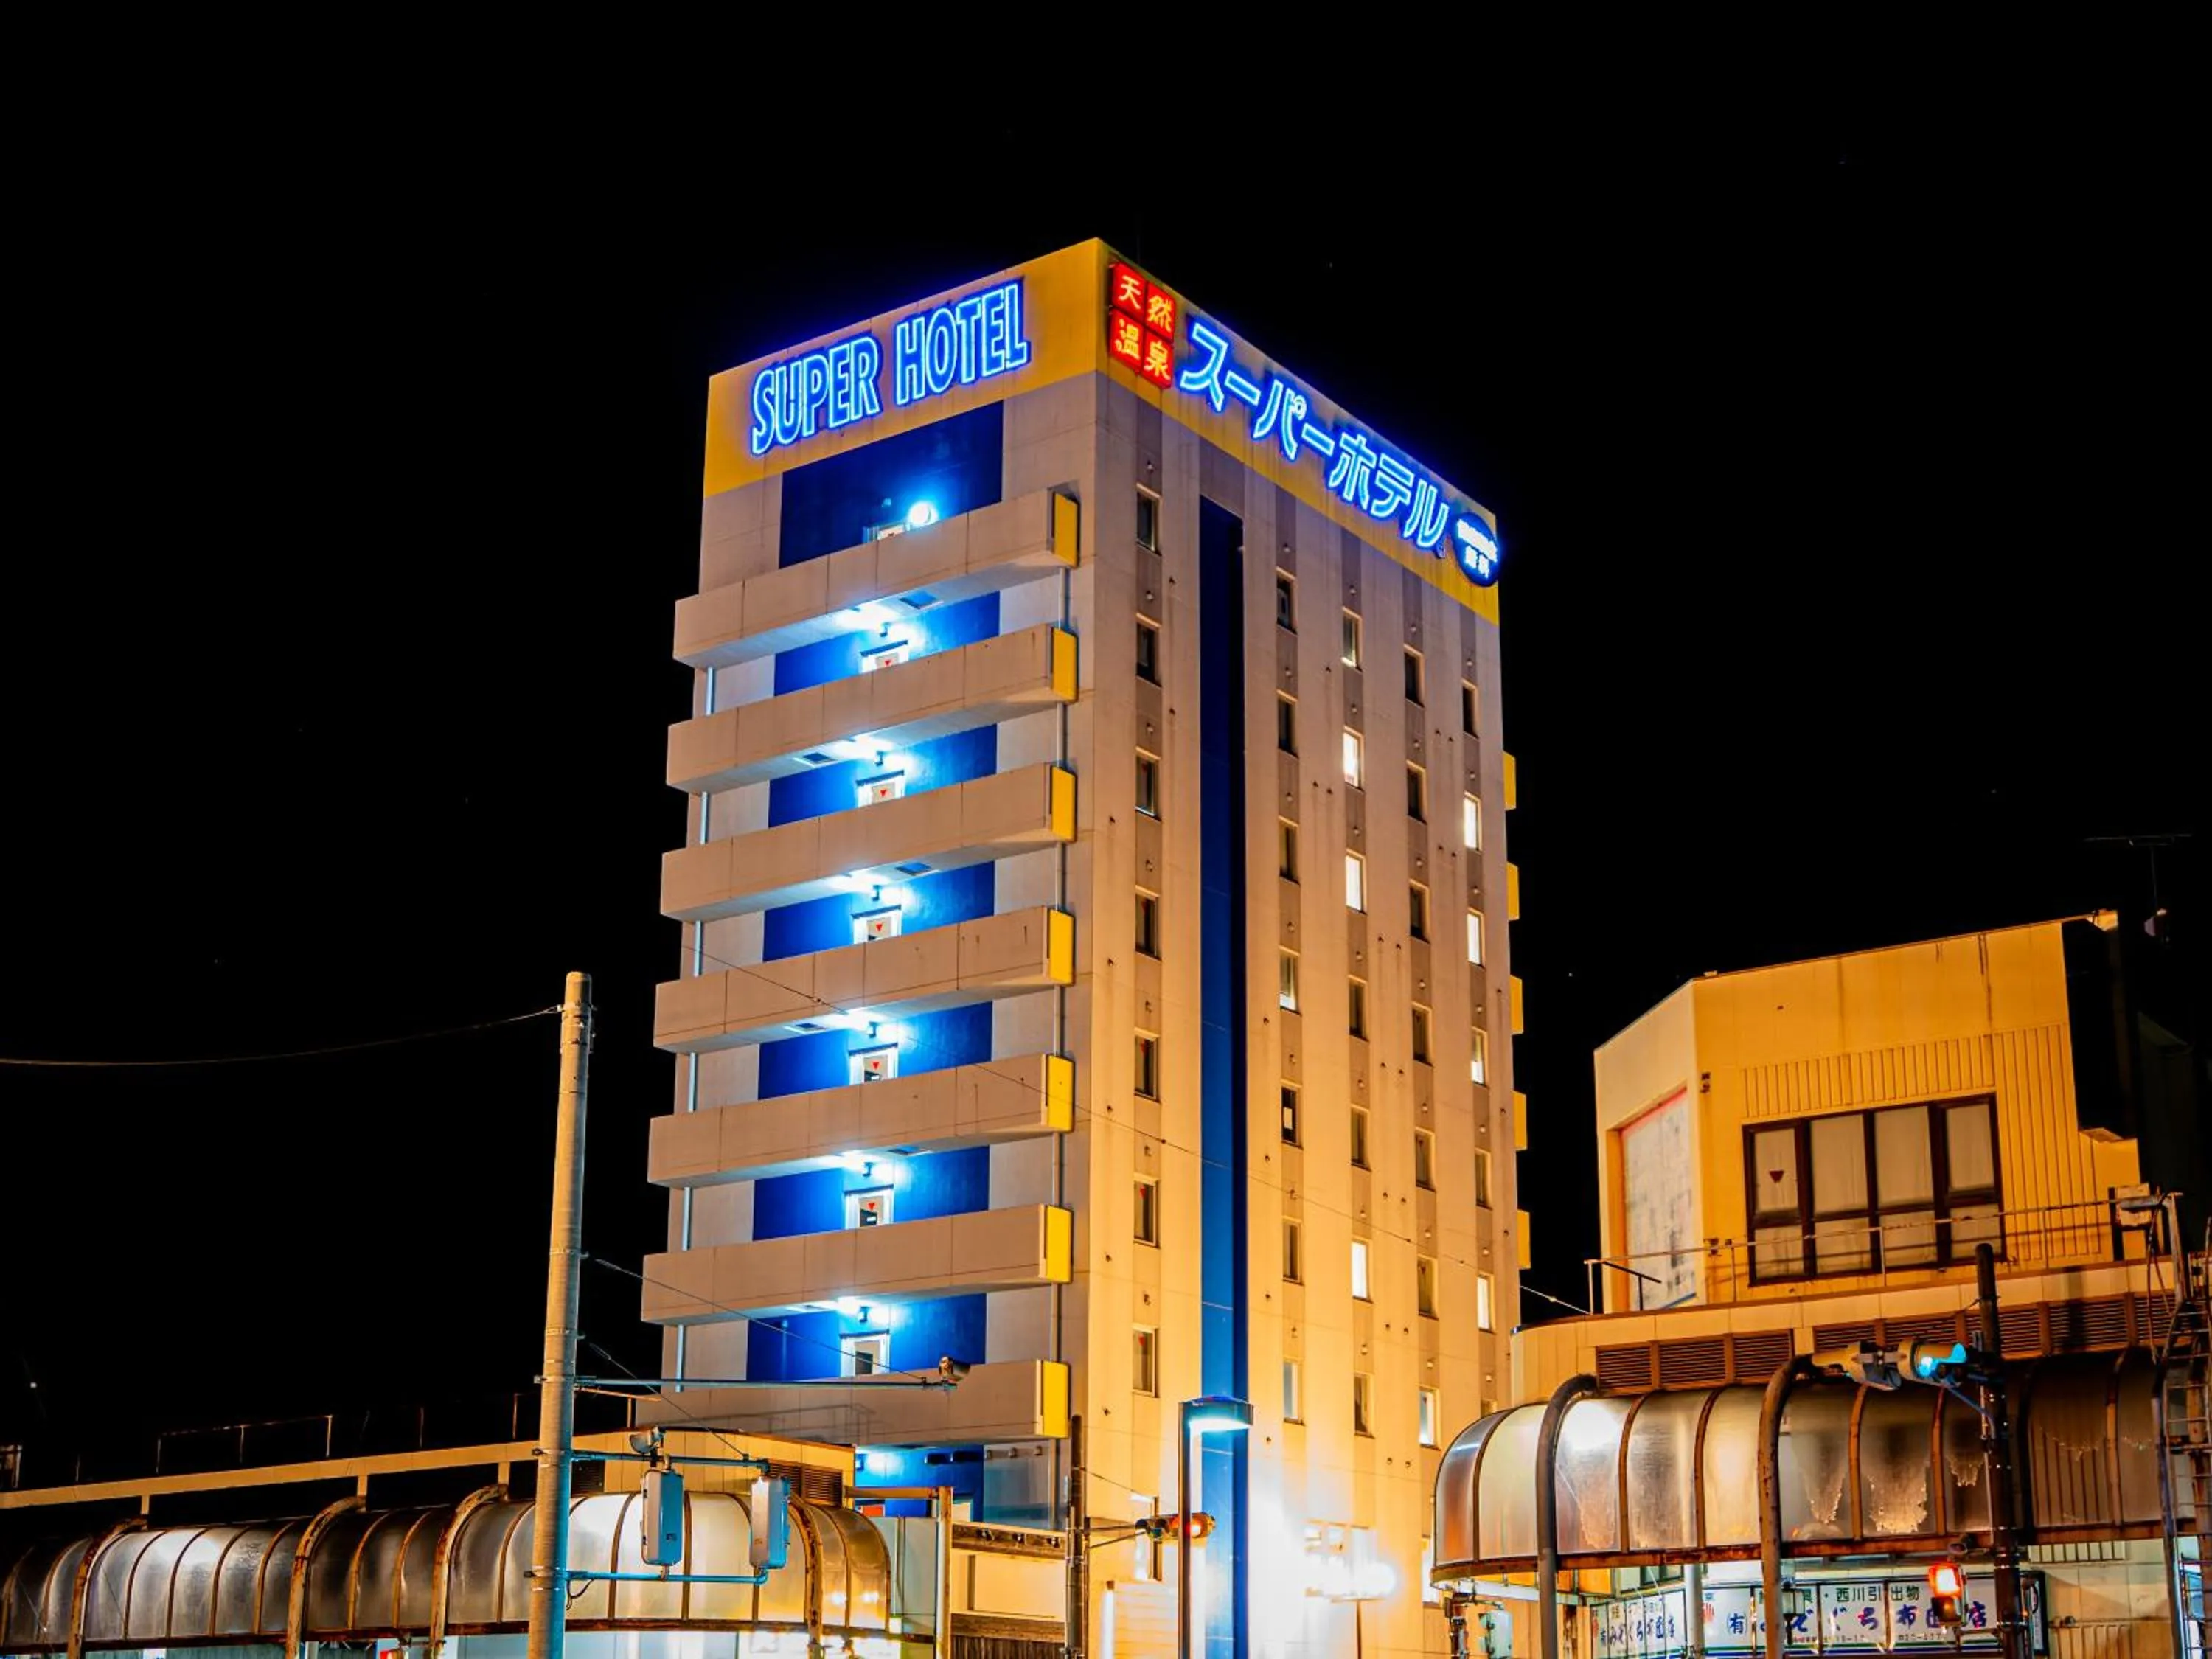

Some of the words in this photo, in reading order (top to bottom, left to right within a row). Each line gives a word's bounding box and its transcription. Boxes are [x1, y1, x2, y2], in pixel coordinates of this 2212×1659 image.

[1114, 318, 1172, 381] 温泉
[1118, 274, 1172, 333] 天然
[751, 335, 880, 455] SUPER
[895, 282, 1029, 406] HOTEL
[1179, 321, 1450, 549] スーパーホテル
